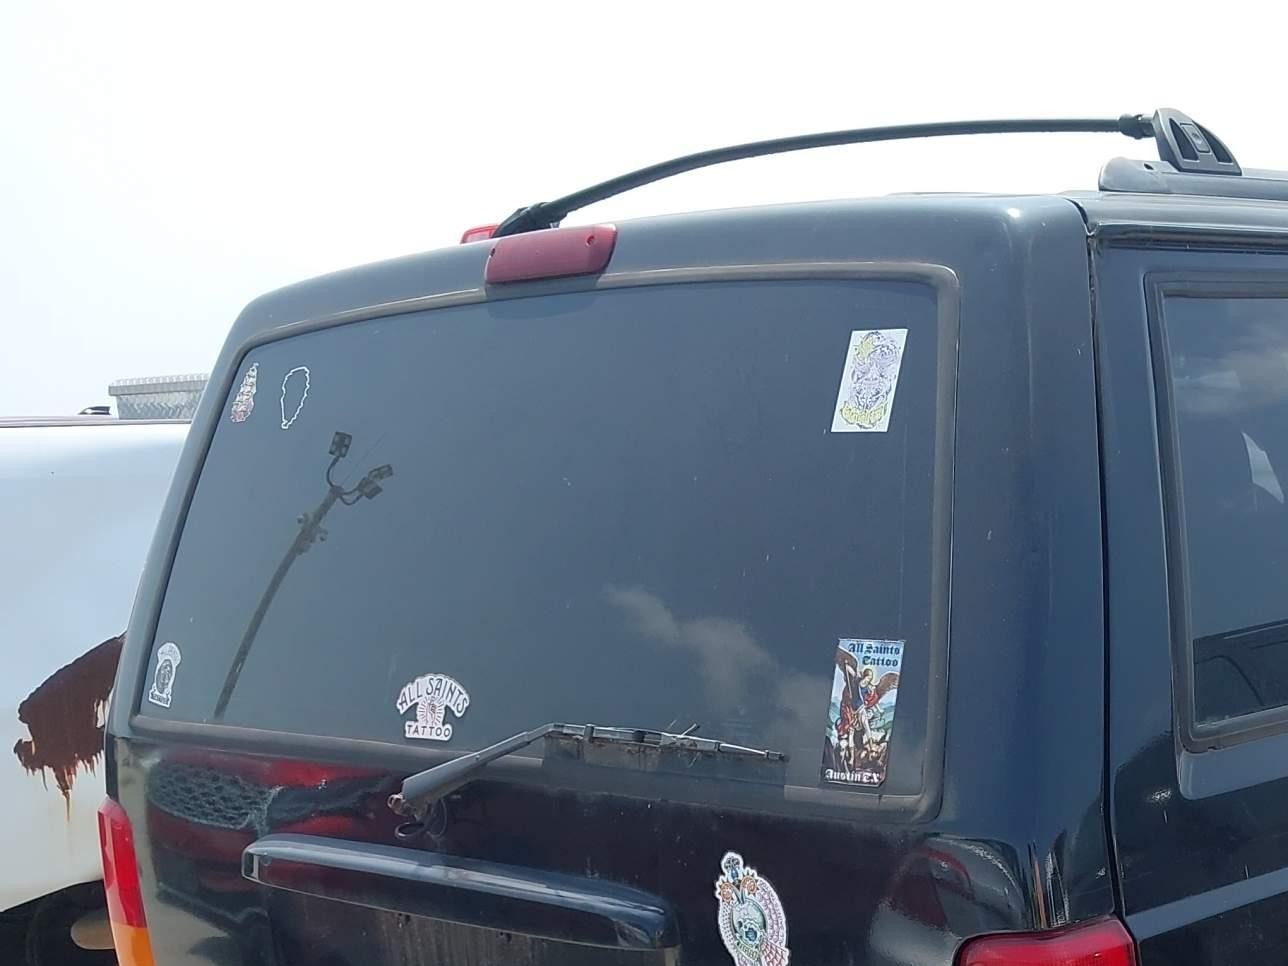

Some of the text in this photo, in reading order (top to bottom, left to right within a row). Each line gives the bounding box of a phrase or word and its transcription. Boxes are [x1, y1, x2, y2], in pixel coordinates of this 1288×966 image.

[847, 642, 901, 655] All Saints
[862, 655, 899, 667] Tattoo
[399, 677, 468, 713] ALL SAINTS
[407, 724, 451, 737] TATTOO
[825, 769, 861, 782] Austin
